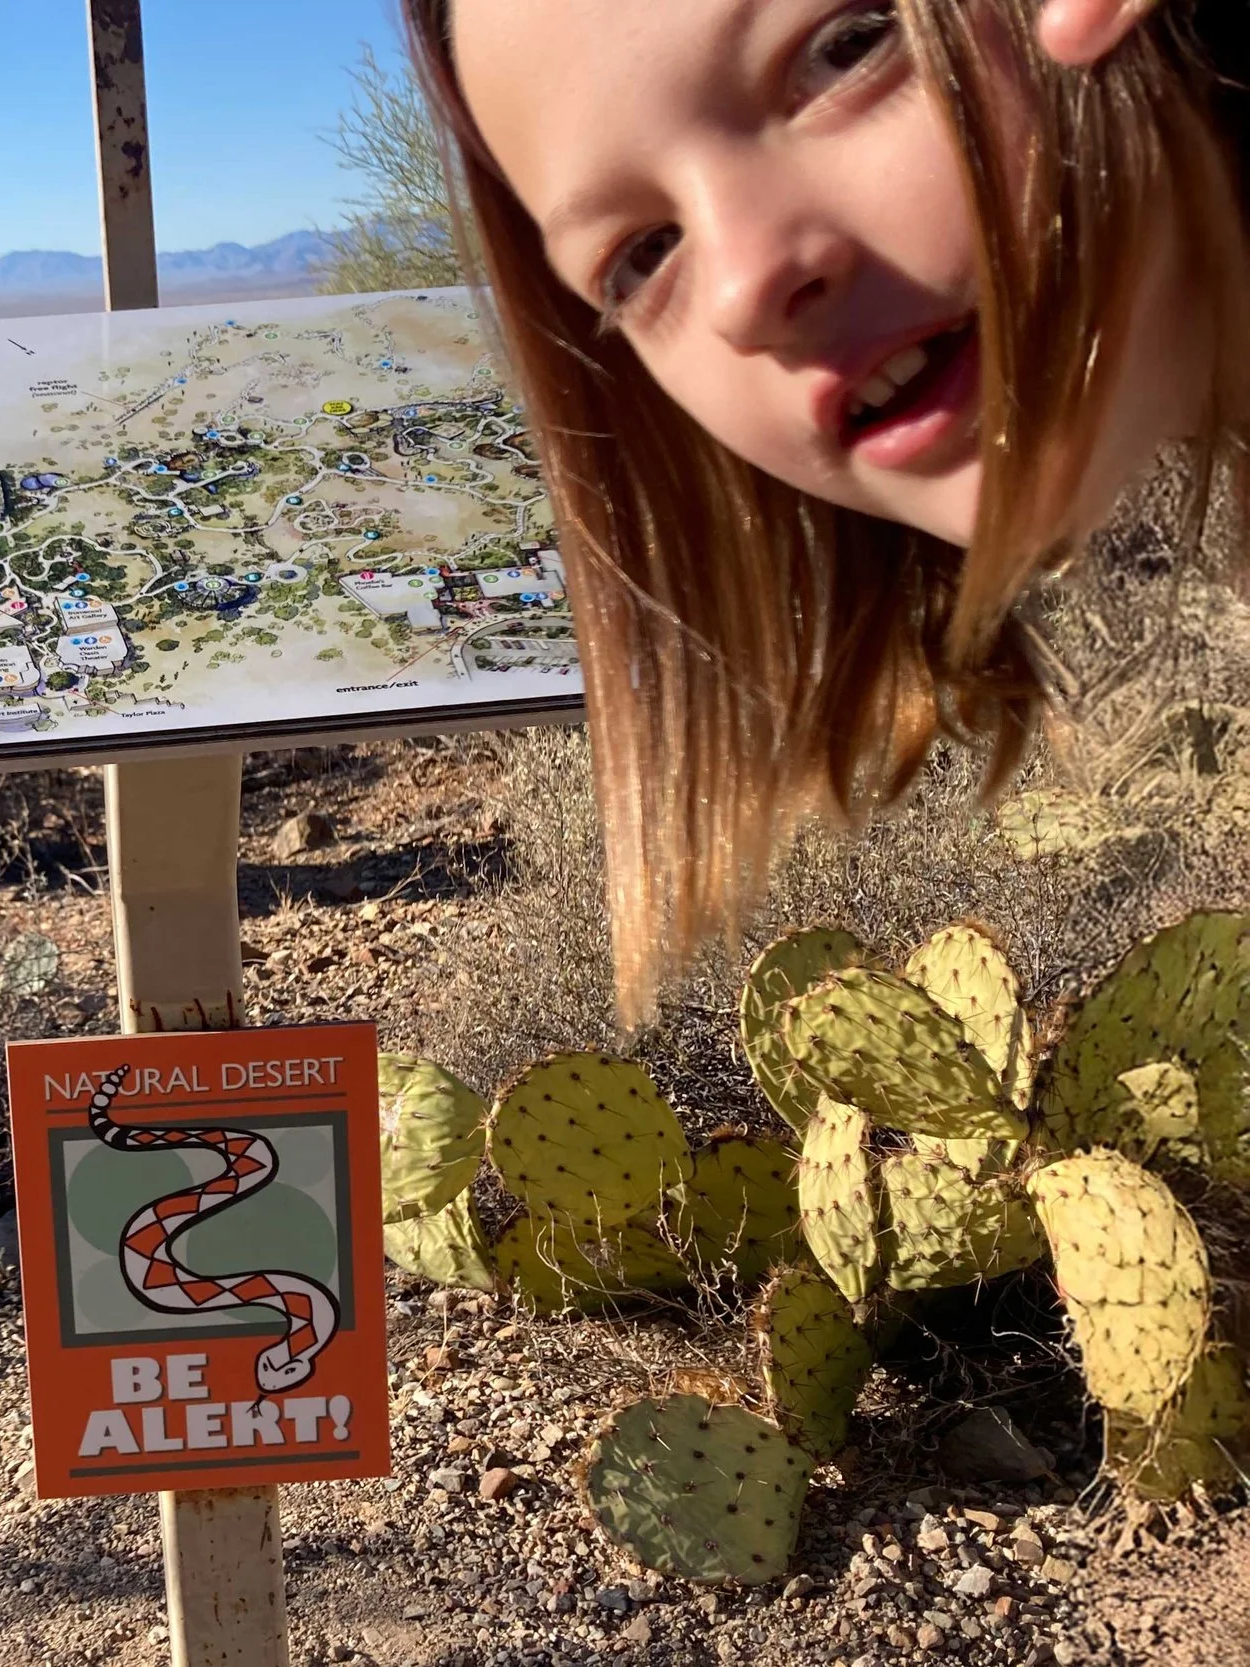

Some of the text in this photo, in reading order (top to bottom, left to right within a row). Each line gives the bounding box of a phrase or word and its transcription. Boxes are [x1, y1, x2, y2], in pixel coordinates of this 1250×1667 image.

[335, 680, 420, 693] entrance/exit
[221, 1056, 344, 1090] DESERT
[110, 1353, 210, 1404] BE
[78, 1394, 352, 1457] ALERT!
